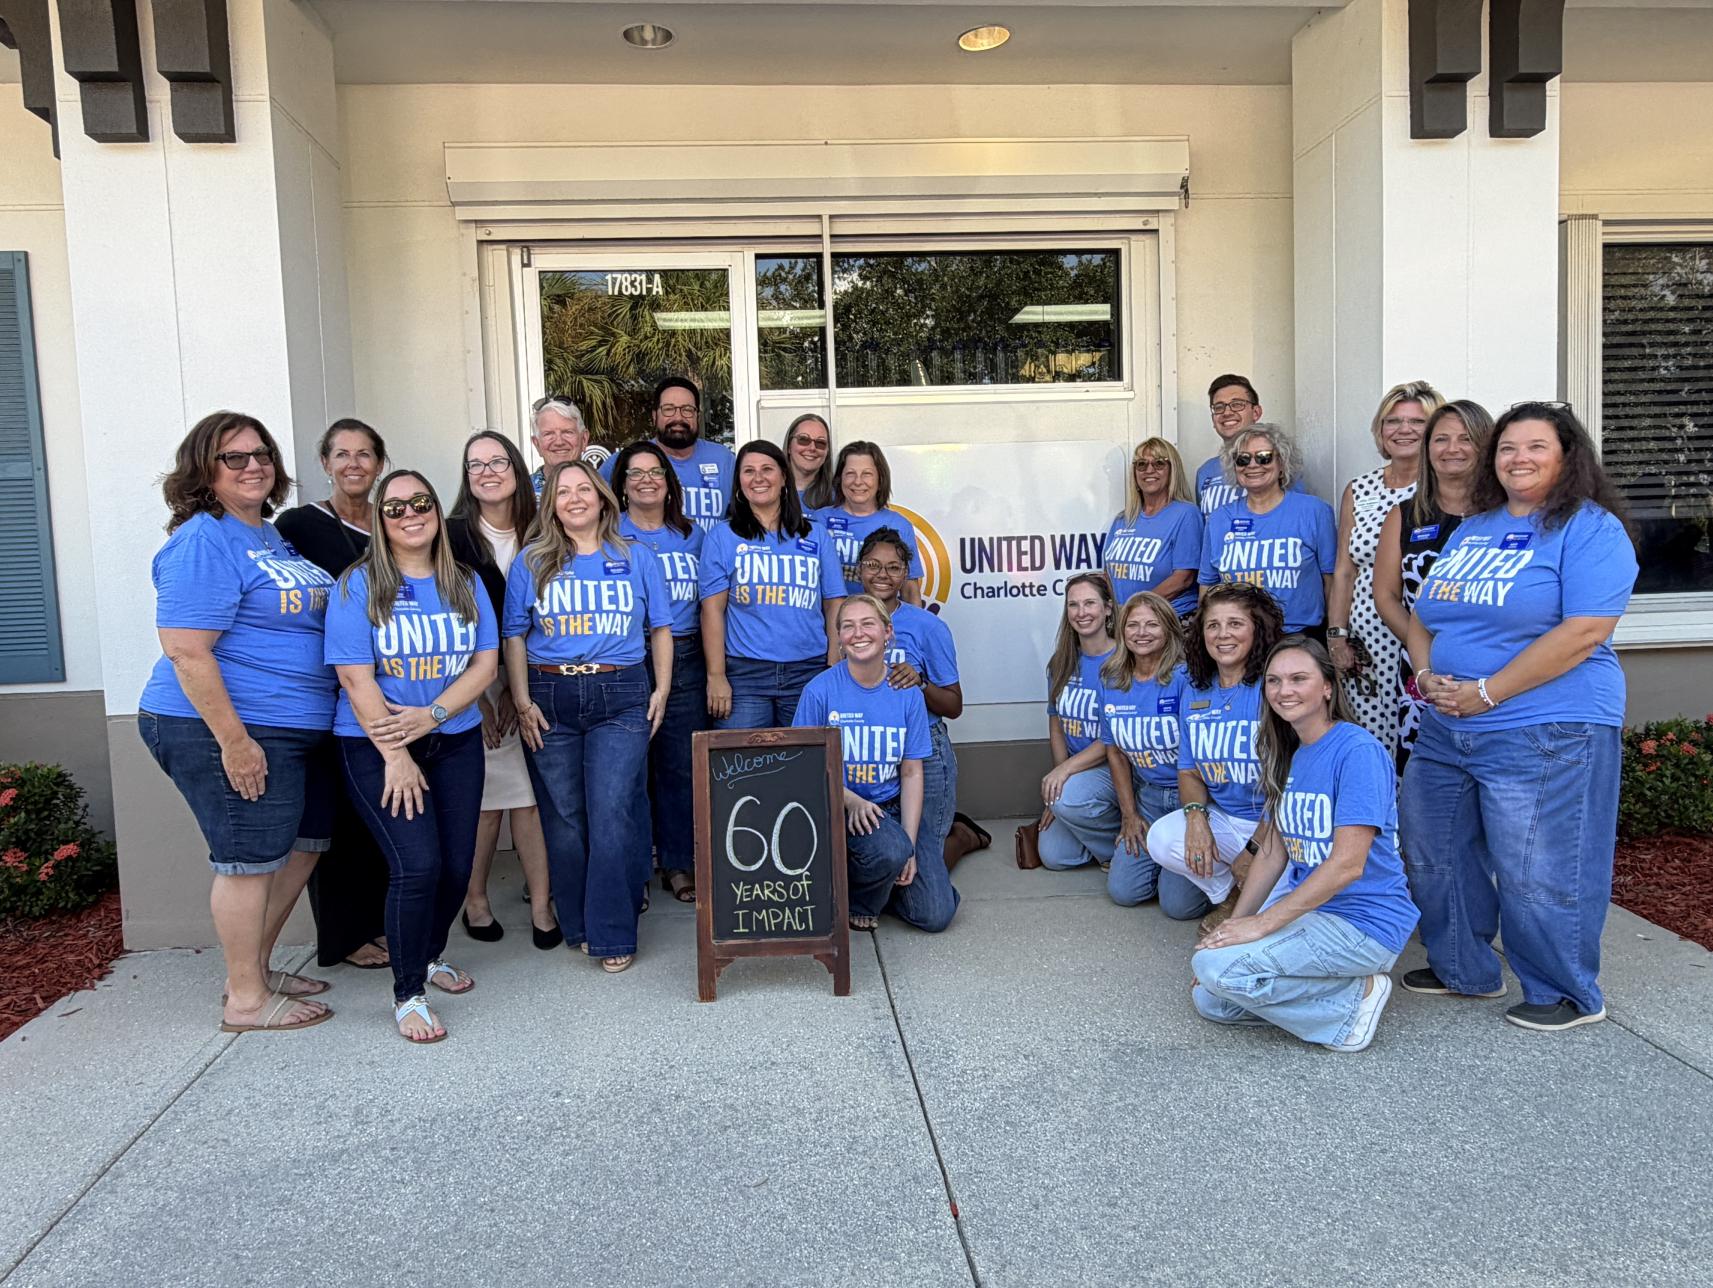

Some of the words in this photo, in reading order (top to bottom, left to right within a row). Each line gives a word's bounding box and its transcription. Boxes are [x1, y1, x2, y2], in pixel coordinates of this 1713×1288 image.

[605, 273, 663, 296] 17831-A
[681, 486, 723, 517] ITED
[959, 535, 1046, 575] UNITED
[1050, 533, 1107, 571] WAY
[1219, 537, 1303, 572] UNITED
[1428, 545, 1534, 579] UNITED
[735, 553, 819, 588] UNITED
[1129, 563, 1154, 582] WAY
[1266, 569, 1301, 589] WAY
[280, 589, 302, 614] IS
[534, 579, 633, 616] UNITED
[735, 585, 751, 605] IS
[756, 585, 787, 605] THE
[787, 586, 817, 610] WAY
[960, 580, 1048, 599] Charlotte
[1429, 580, 1466, 602] THE
[1463, 580, 1514, 606] WAY
[539, 617, 555, 638] IS
[558, 613, 593, 636] THE
[595, 612, 632, 637] WAY
[382, 658, 404, 678] IS
[408, 656, 443, 681] THE
[444, 655, 472, 677] WA
[1056, 686, 1099, 721] NITE
[712, 751, 803, 781] Welcome
[847, 764, 877, 784] THE
[1227, 761, 1262, 785] WA
[1275, 791, 1333, 839] NITED
[725, 795, 818, 876] 60
[731, 879, 788, 905] YEARS
[733, 905, 817, 933] IMPACT
